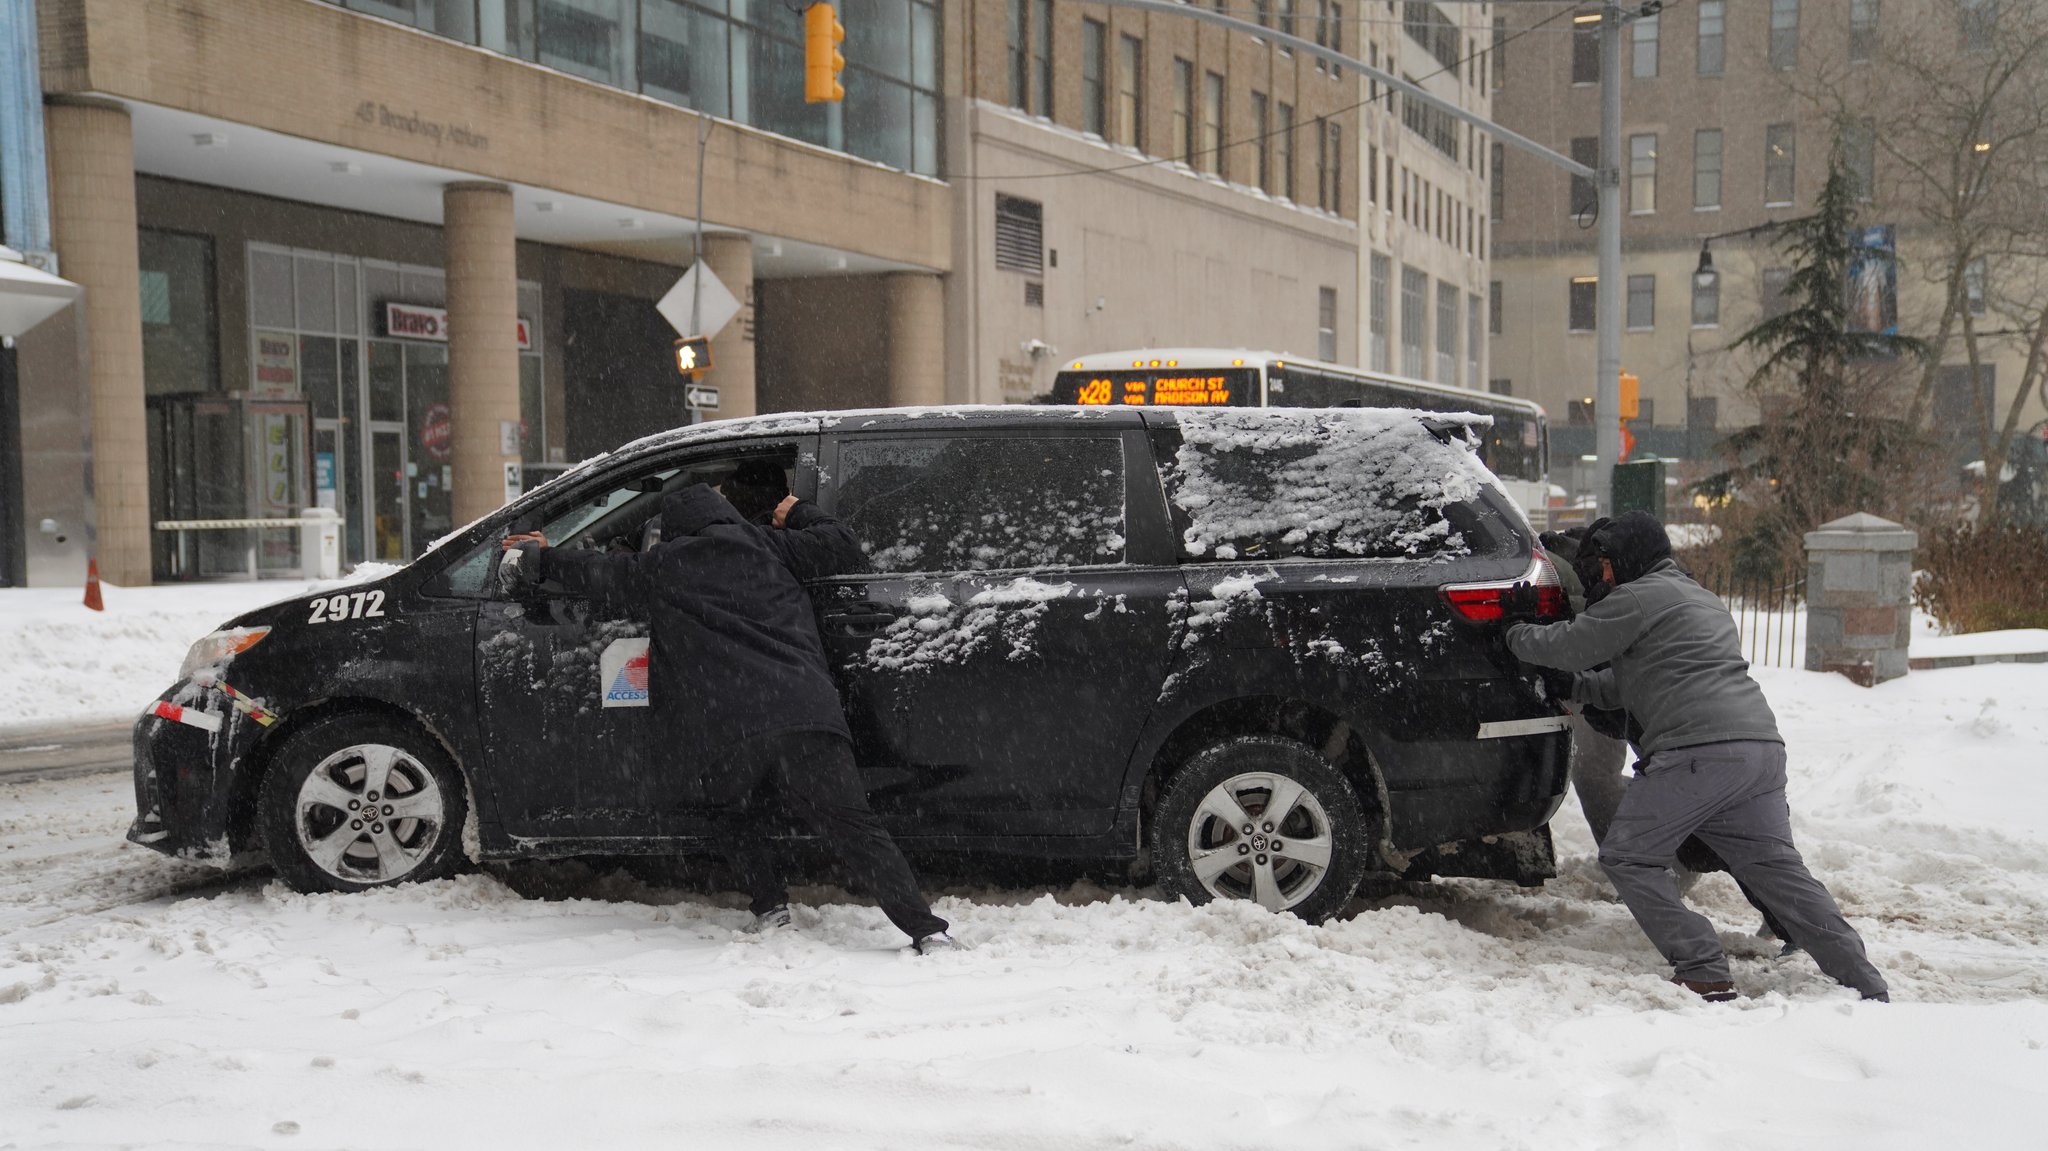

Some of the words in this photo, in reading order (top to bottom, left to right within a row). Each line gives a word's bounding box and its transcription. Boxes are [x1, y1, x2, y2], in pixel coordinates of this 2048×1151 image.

[379, 103, 442, 147] Broadway
[391, 306, 438, 334] Bravo
[1078, 379, 1112, 404] x28
[1155, 378, 1206, 391] CHURCH
[1207, 377, 1225, 390] ST
[1154, 391, 1209, 404] MADISON
[1211, 390, 1230, 403] AV
[308, 589, 386, 625] 2972
[607, 690, 648, 700] ACCESS
